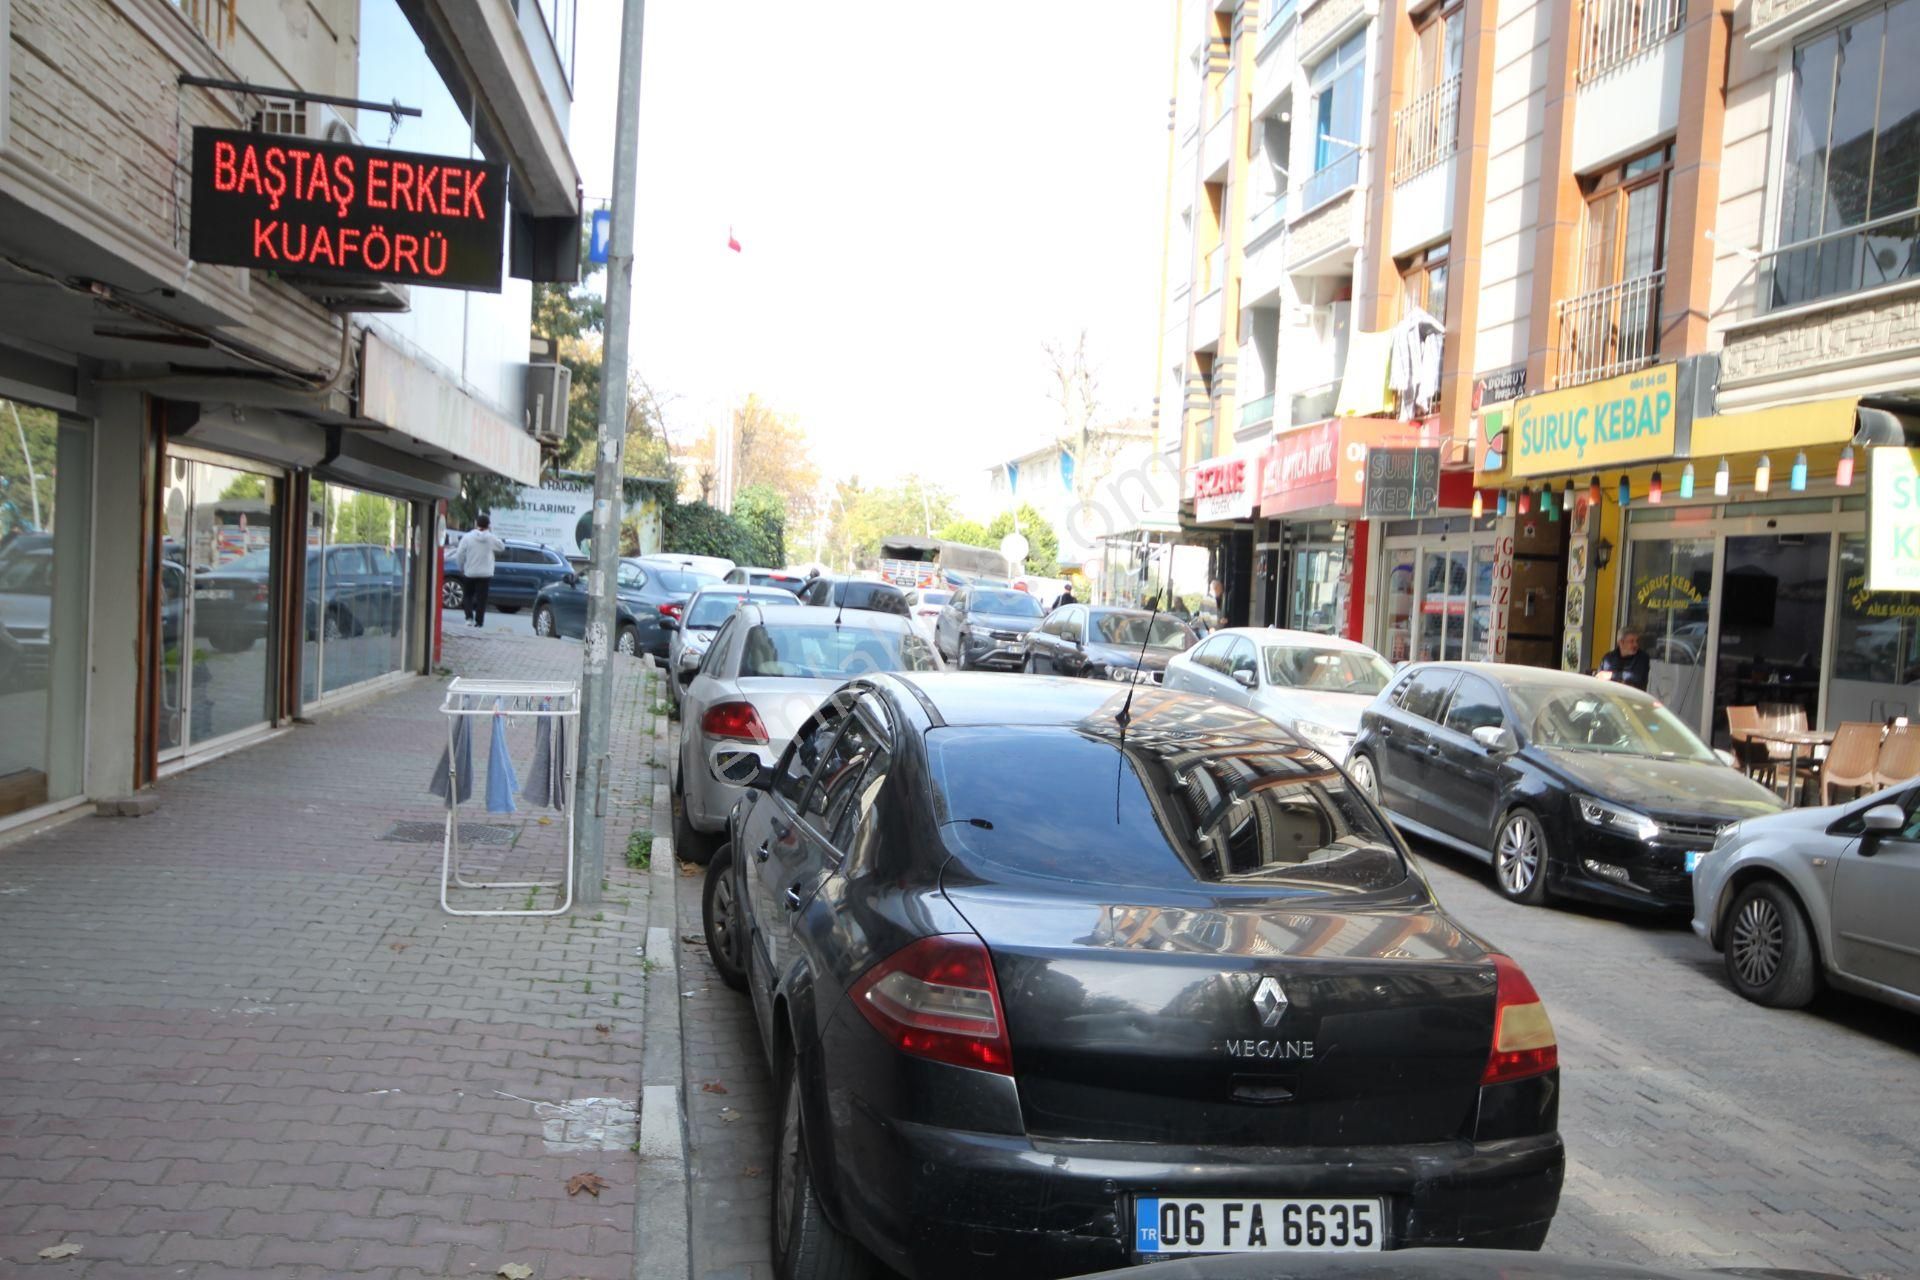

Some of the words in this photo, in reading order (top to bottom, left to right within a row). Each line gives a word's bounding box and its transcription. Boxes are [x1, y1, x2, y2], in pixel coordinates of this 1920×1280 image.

[214, 141, 355, 218] BAŞTAŞ
[367, 158, 487, 220] ERKEK
[253, 218, 447, 276] KUAFÖRÜ
[1519, 406, 1590, 460] SURUÇ
[1593, 390, 1672, 445] KEBAP
[547, 480, 582, 493] HAKAN
[1195, 460, 1246, 499] ECZANE
[1371, 453, 1435, 483] SURUÇ
[1368, 487, 1437, 512] KEBAP
[1225, 1039, 1314, 1059] MEGANE
[1140, 1228, 1157, 1241] TR
[1160, 1202, 1205, 1246] 06
[1223, 1203, 1267, 1247] FA
[1282, 1204, 1374, 1247] 6635
